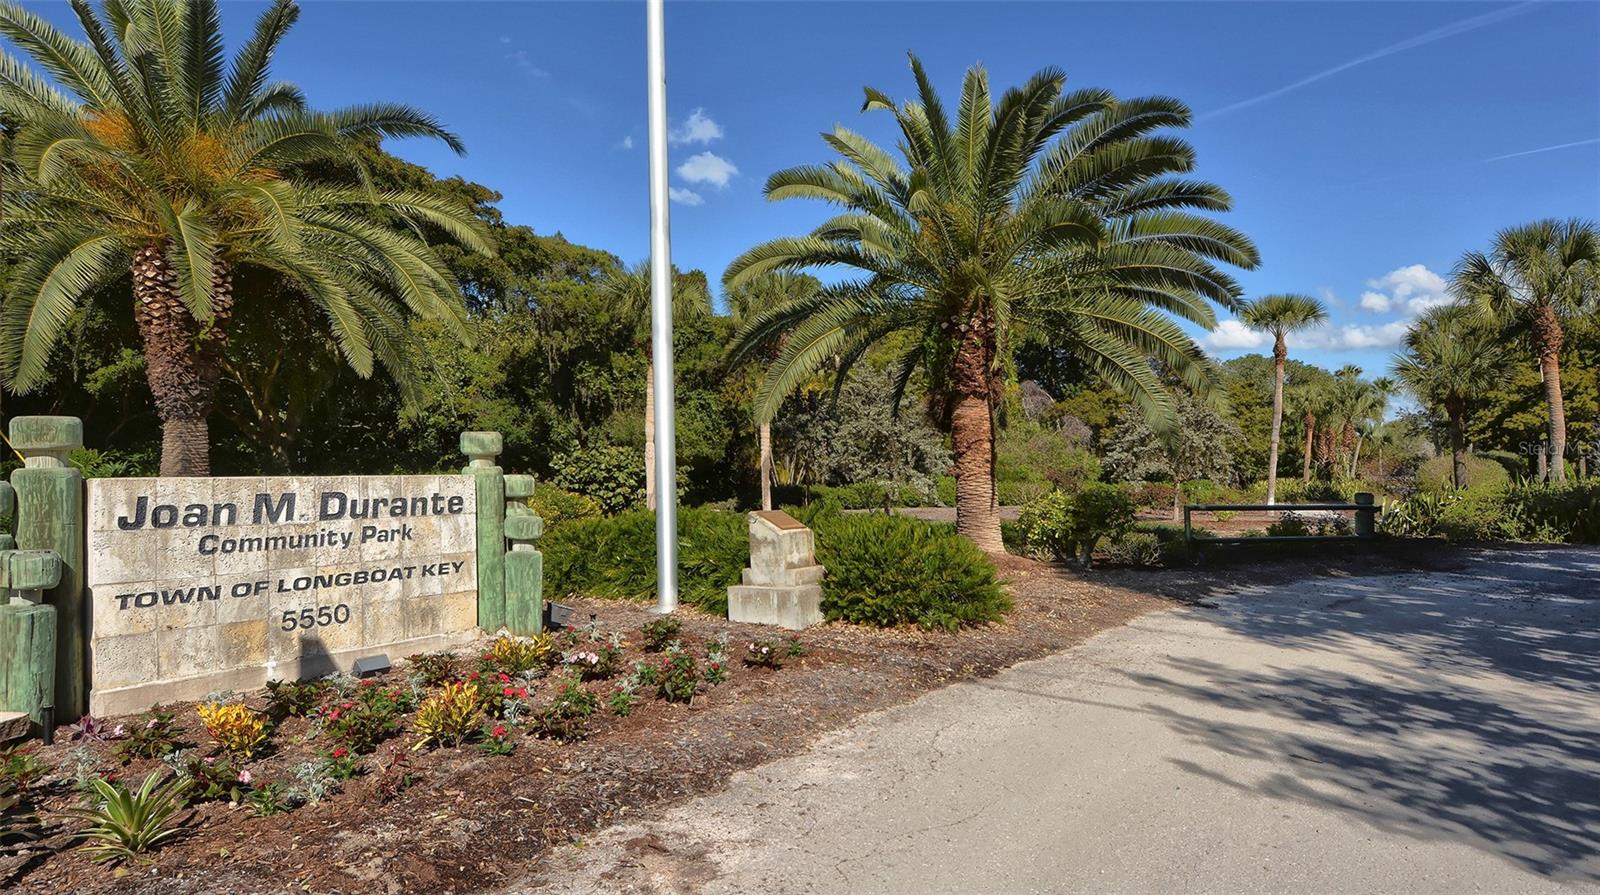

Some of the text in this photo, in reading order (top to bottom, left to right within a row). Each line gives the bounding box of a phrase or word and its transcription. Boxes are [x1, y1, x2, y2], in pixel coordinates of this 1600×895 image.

[117, 495, 237, 530] Joan
[319, 491, 464, 521] Durante
[198, 523, 413, 556] Community Park
[115, 560, 465, 611] TOWN OF LONGBOAT KEY
[281, 603, 351, 632] 5550
